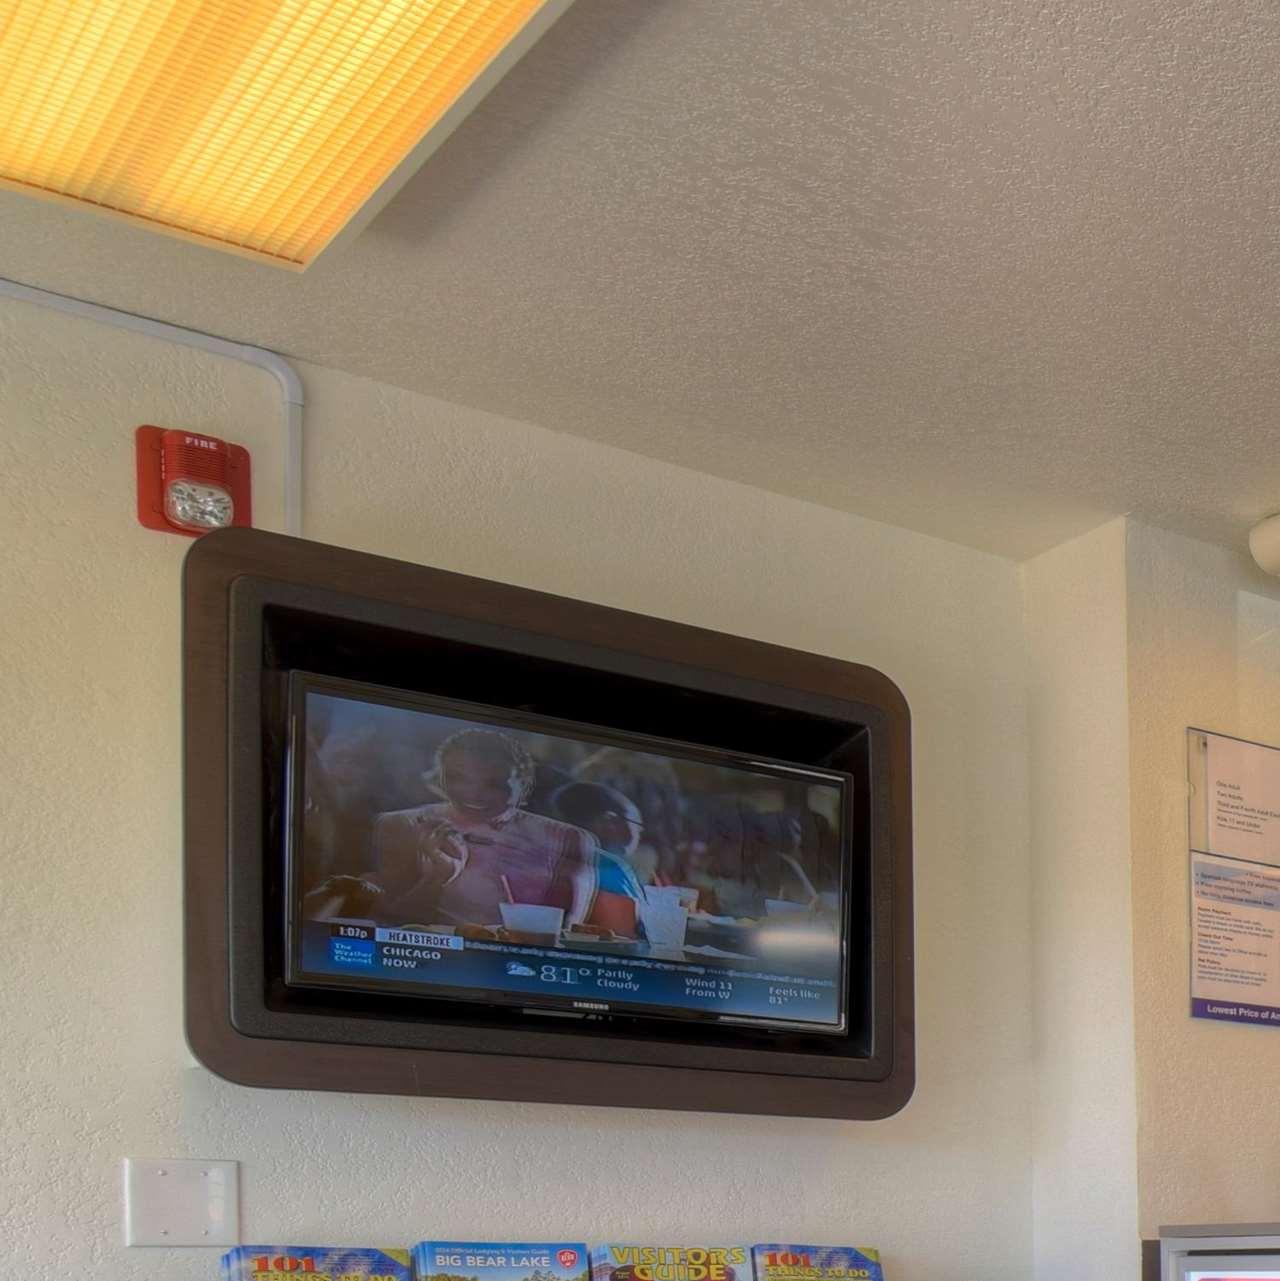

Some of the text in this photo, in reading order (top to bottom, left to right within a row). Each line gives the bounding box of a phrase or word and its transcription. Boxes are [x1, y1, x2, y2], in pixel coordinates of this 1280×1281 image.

[185, 437, 217, 449] FIRE
[389, 931, 451, 947] HEATSTROKE
[335, 943, 351, 951] The
[383, 946, 441, 960] CHICAGO
[335, 949, 372, 959] Weather
[335, 956, 372, 965] Channel
[382, 958, 417, 969] NOW
[597, 968, 634, 980] Partly
[597, 978, 640, 991] Cloudy
[685, 978, 716, 989] Wind
[685, 987, 731, 999] From W
[769, 987, 821, 999] Feels like
[573, 1001, 609, 1011] SAMSUNG
[1207, 1004, 1237, 1016] Lowest
[1239, 1008, 1259, 1018] Price
[435, 1255, 550, 1267] BIG BEAR LAKE
[611, 1246, 746, 1265] VISITORS
[765, 1252, 811, 1267] 101
[255, 1256, 317, 1272] 101
[634, 1265, 727, 1281] GUIDE
[766, 1265, 869, 1278] THINGS TO DO
